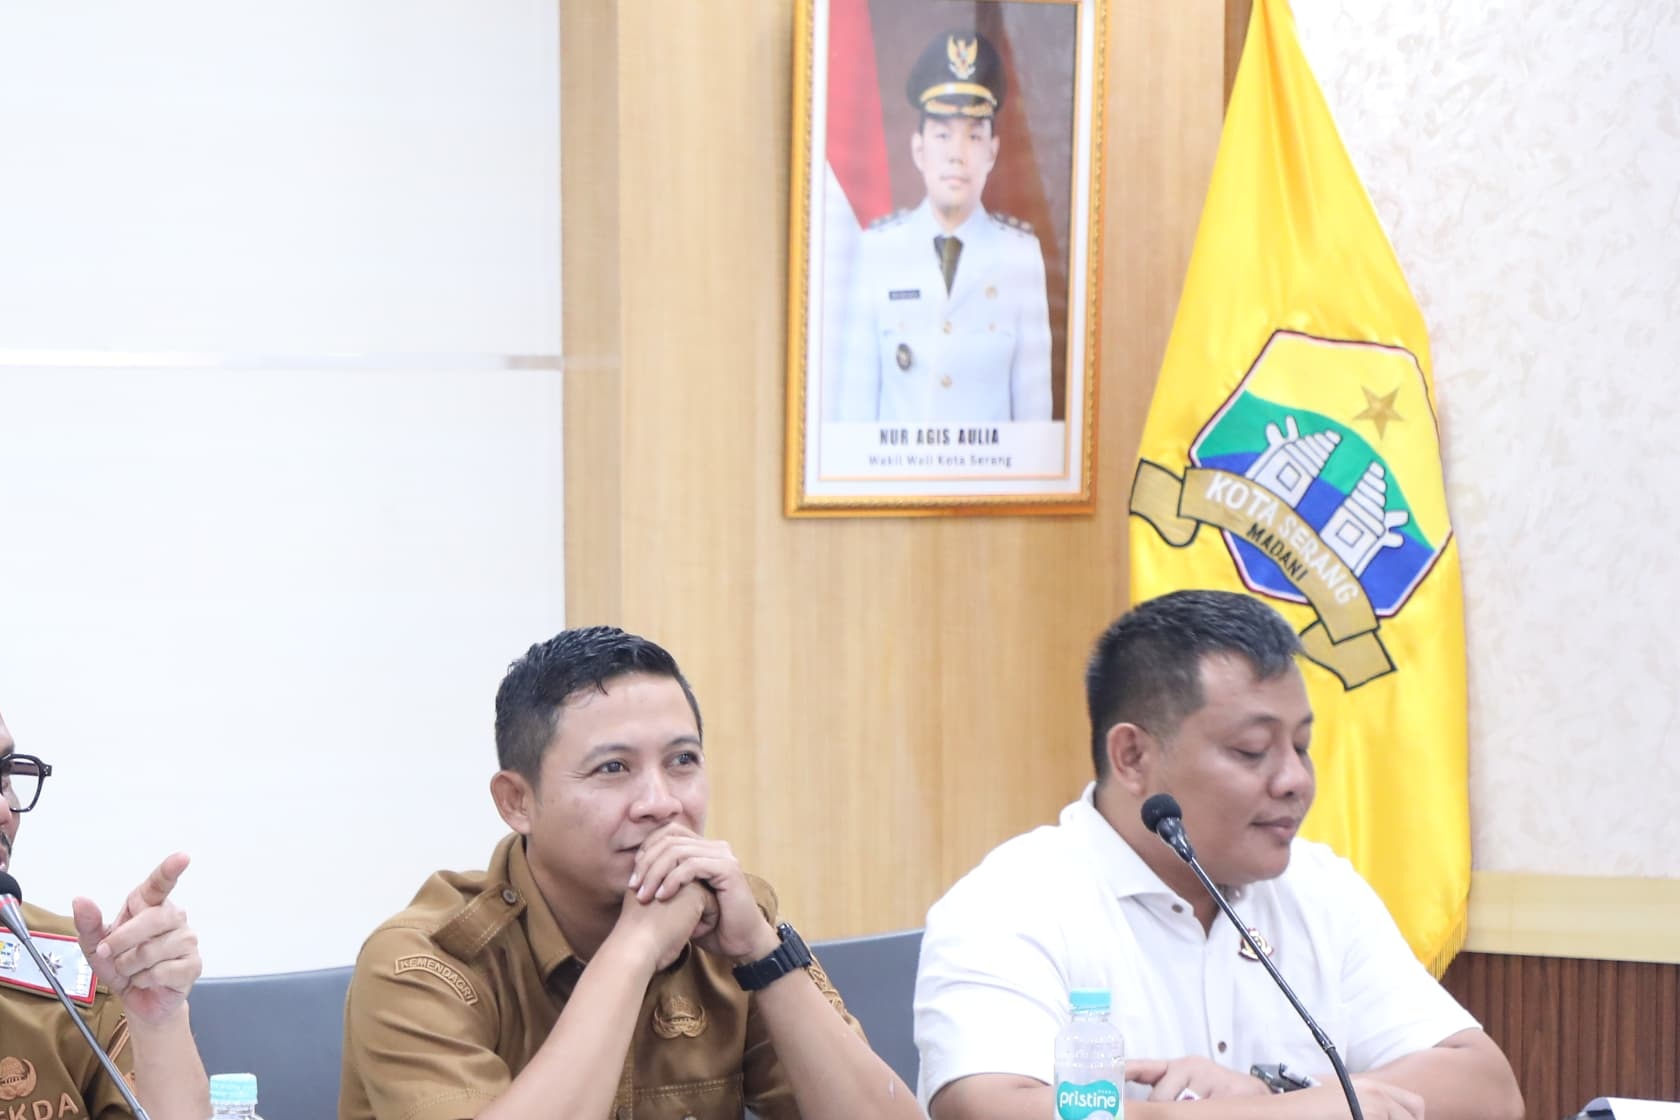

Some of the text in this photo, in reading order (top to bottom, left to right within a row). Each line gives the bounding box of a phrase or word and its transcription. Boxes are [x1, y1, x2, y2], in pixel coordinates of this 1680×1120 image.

[879, 427, 999, 446] NUR AGIS AULIA
[937, 455, 966, 465] Kota
[969, 454, 1012, 468] Serang
[1204, 471, 1360, 606] KOTA SERANG
[1246, 522, 1309, 582] MADANI
[400, 958, 474, 1000] KEMENDAGRI
[1059, 1090, 1117, 1109] pristine
